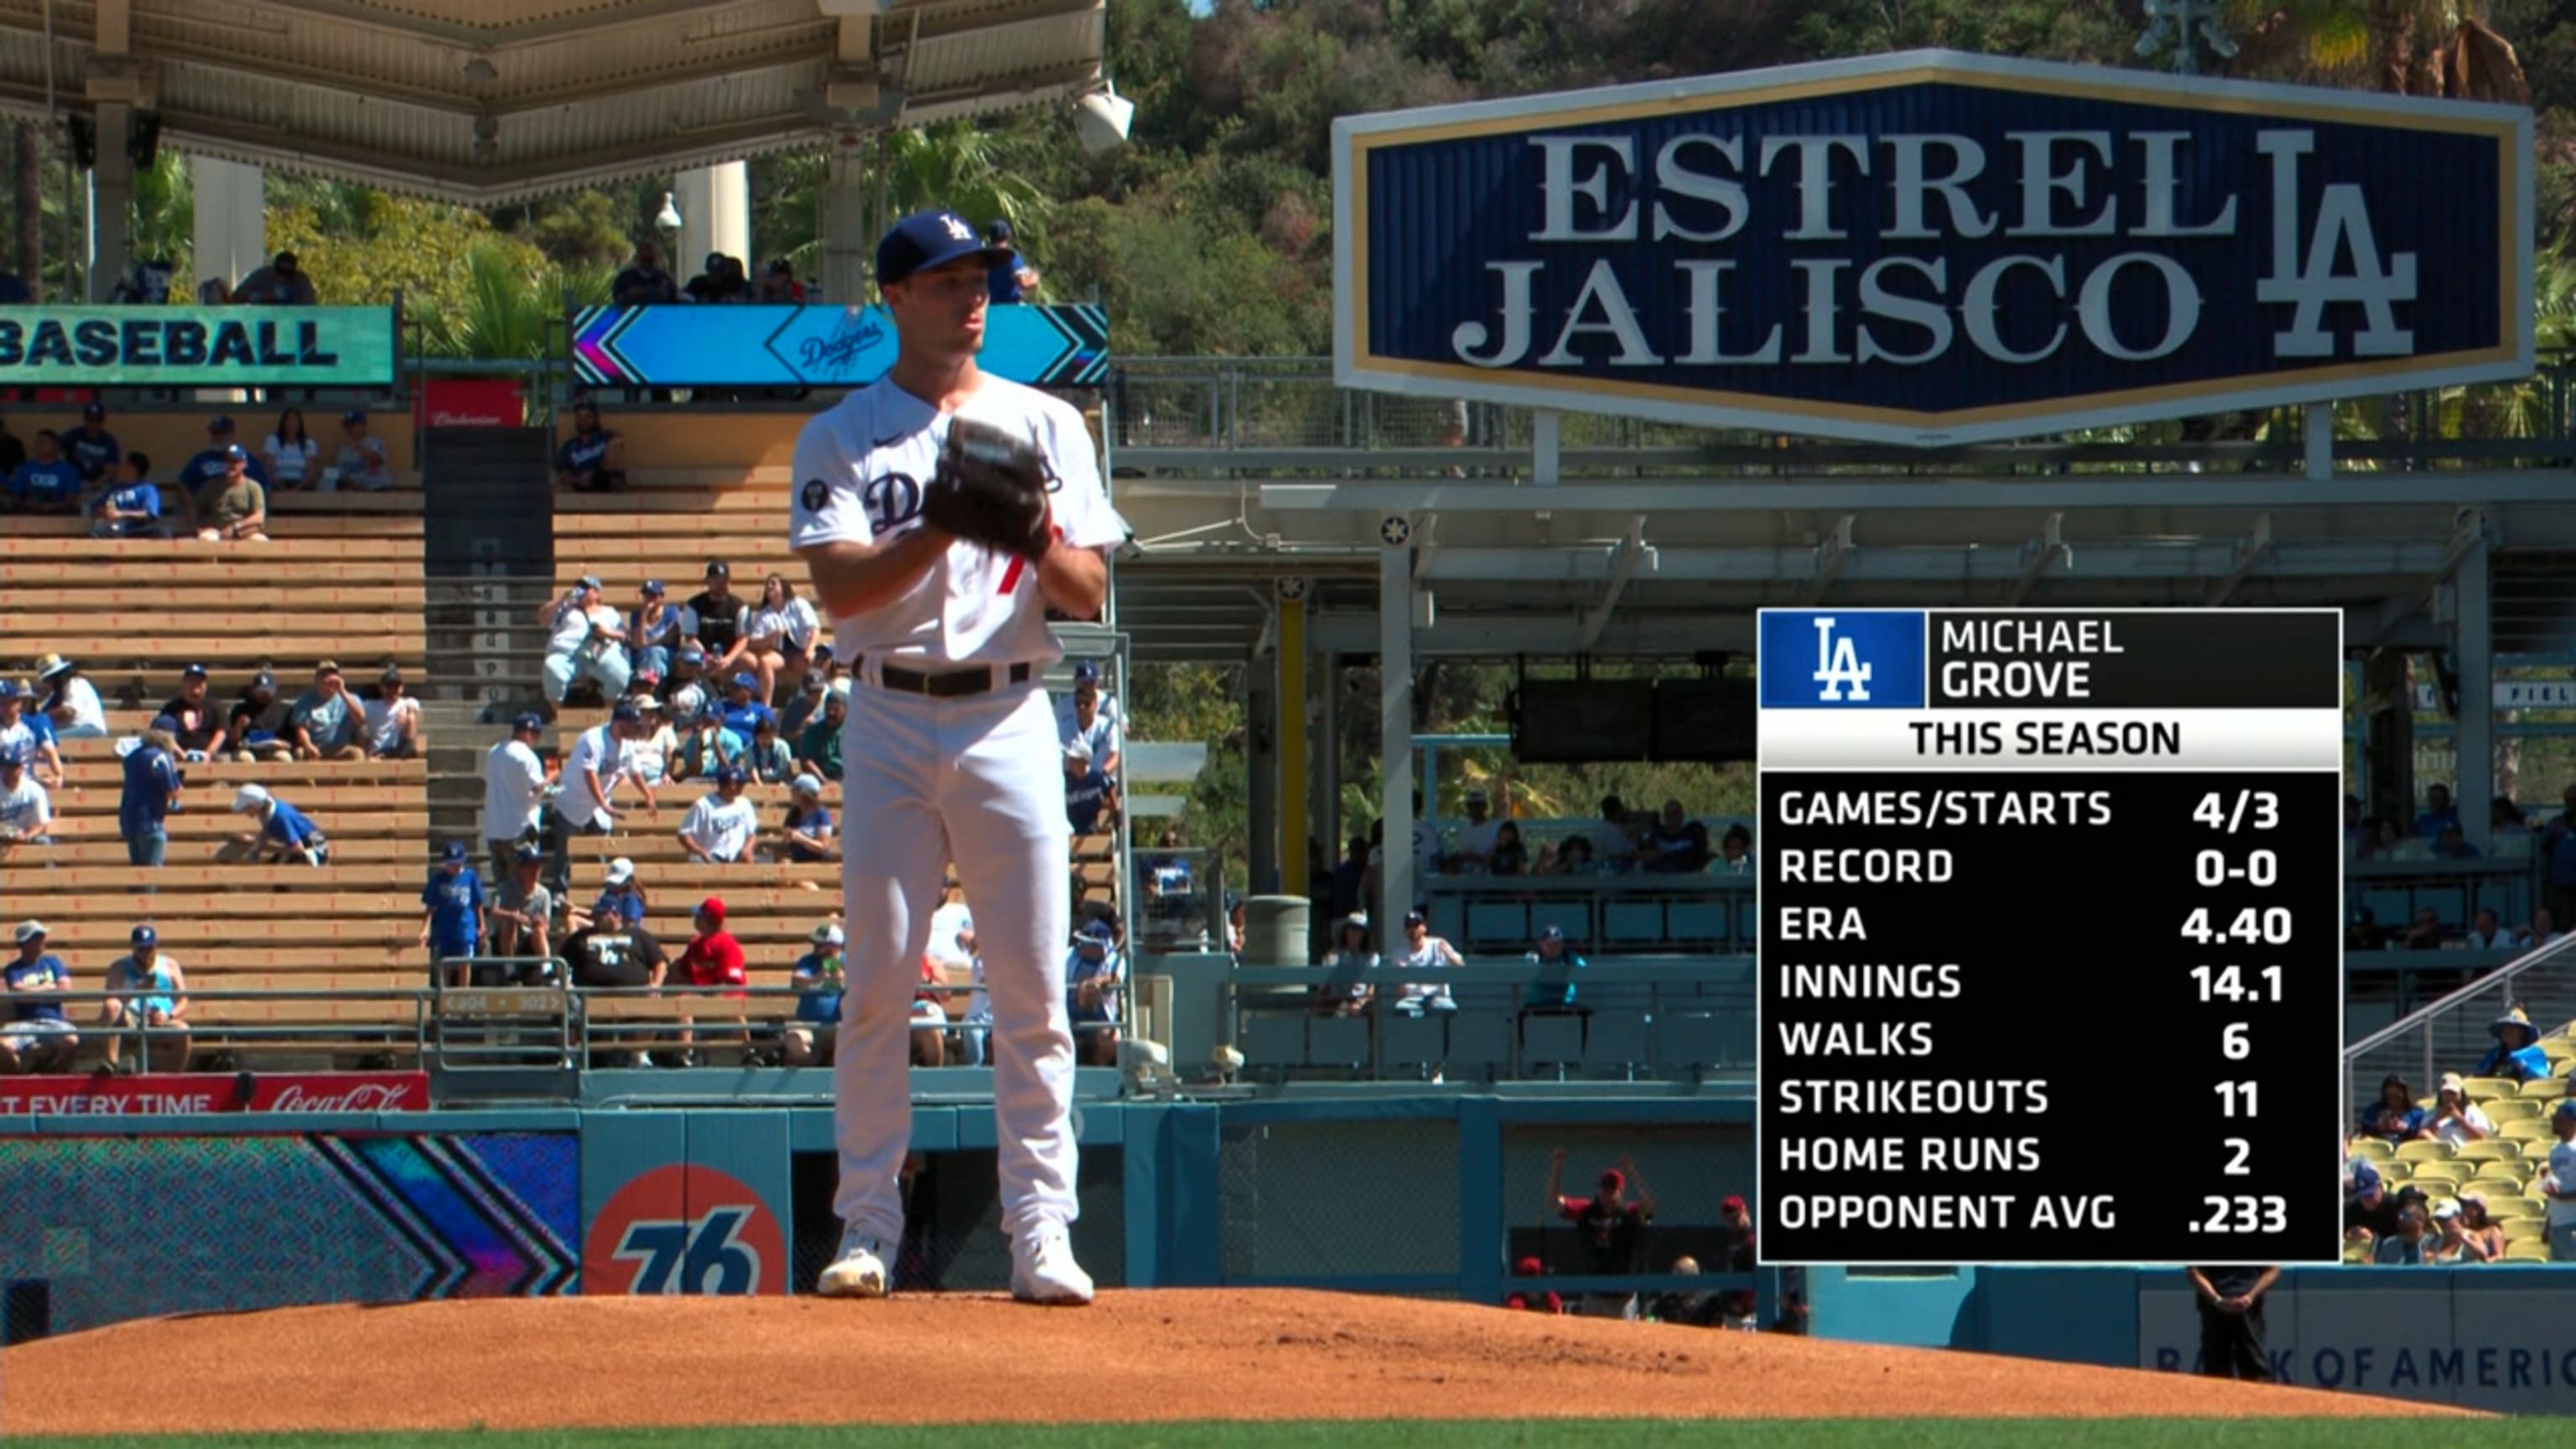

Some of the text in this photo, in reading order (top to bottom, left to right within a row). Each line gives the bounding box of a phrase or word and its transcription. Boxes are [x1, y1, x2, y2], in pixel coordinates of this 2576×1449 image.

[1527, 130, 2238, 242] ESTREL
[939, 213, 973, 240] LA
[2257, 128, 2418, 357] LA
[1452, 252, 2206, 368] JALISCO
[0, 319, 338, 366] BASEBALL
[799, 321, 885, 369] Dodgers
[29, 1095, 128, 1115] EVERY
[137, 1094, 212, 1115] TIME
[612, 1205, 761, 1295] 76
[2157, 1348, 2295, 1385] BK
[2312, 1347, 2376, 1388] OF
